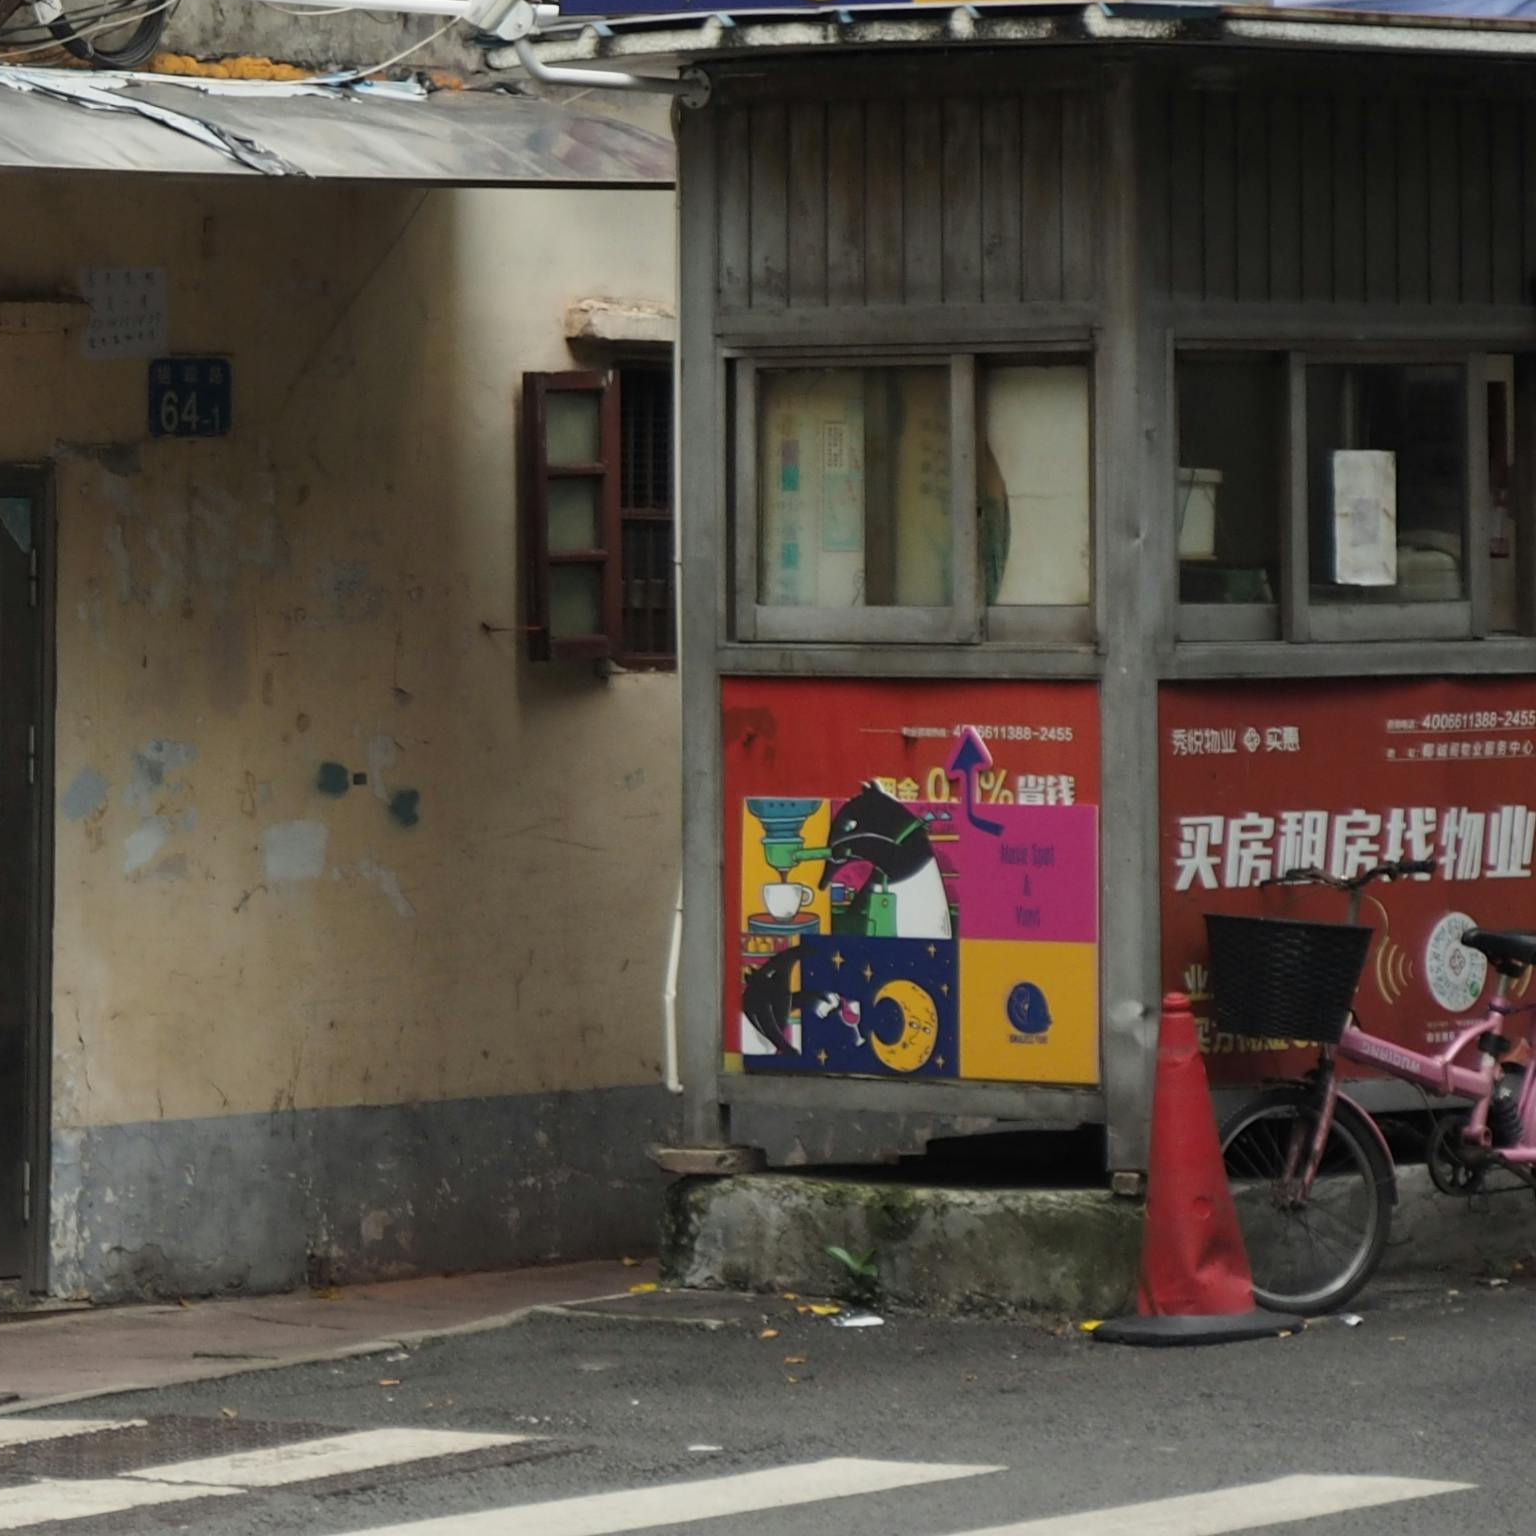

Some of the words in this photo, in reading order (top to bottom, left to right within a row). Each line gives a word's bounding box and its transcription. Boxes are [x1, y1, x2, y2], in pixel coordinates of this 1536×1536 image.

[160, 391, 221, 432] 64-1
[953, 725, 1072, 742] 46611388-2455
[1175, 805, 1535, 891] 买房租房找物业
